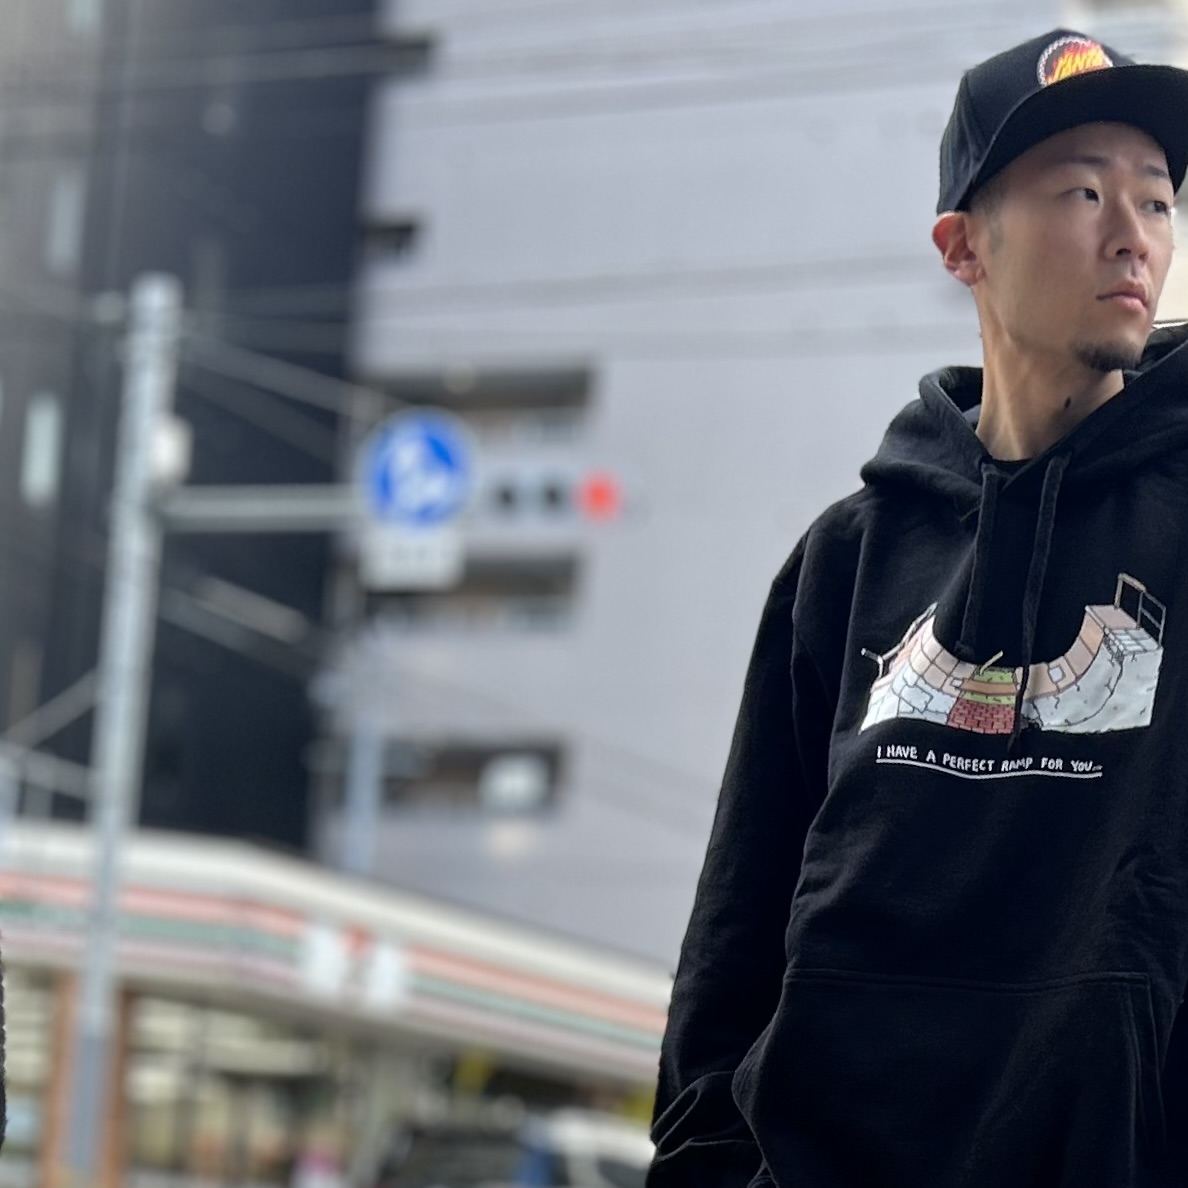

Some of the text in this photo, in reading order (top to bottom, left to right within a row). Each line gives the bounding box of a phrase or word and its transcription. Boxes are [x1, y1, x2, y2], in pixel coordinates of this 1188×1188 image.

[876, 745, 882, 759] I
[886, 744, 918, 760] HAVE
[926, 749, 937, 764] A
[942, 752, 995, 773] PERFECT
[1000, 757, 1033, 773] RAMP
[1040, 757, 1064, 771] FOR
